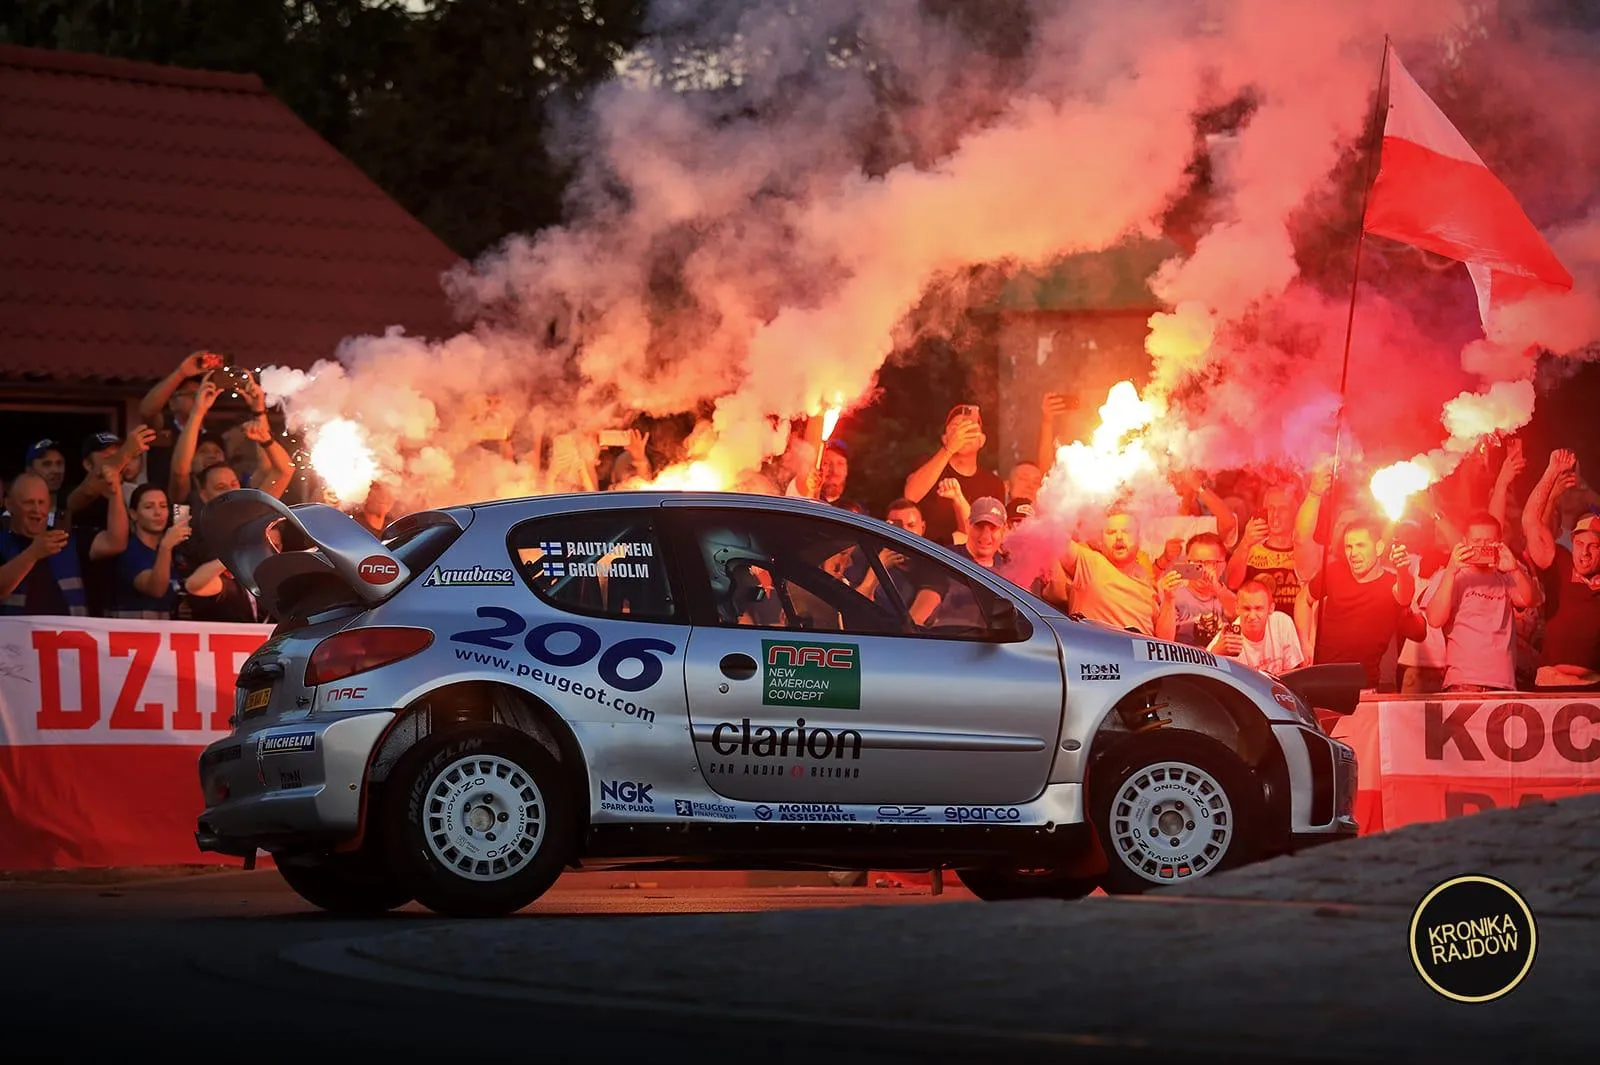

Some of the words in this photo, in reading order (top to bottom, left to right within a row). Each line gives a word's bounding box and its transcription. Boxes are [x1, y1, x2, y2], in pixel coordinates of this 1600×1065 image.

[566, 542, 653, 557] RAUTIAINEN
[361, 563, 397, 575] NAC
[423, 565, 514, 586] Aquabase
[449, 606, 677, 692] 206
[1146, 641, 1218, 667] PETRIHORN
[768, 645, 853, 669] NAC
[769, 668, 796, 678] NEW
[454, 648, 656, 723] www.peugeot.com
[769, 679, 829, 689] AMERICAN
[327, 687, 368, 702] NAC
[768, 690, 824, 701] CONCEPT
[711, 717, 862, 760] clarion
[1424, 702, 1600, 763] KOC
[264, 735, 313, 749] MICHELIN
[710, 763, 734, 774] CAR
[744, 764, 784, 776] AUDIO
[811, 767, 859, 778] BEYOND
[600, 780, 654, 804] NGK
[1153, 784, 1194, 796] RACING
[446, 789, 462, 831] RACING
[601, 802, 626, 811] SPARK
[628, 804, 655, 813] PLUGS
[693, 802, 735, 813] PEUGEOT
[779, 804, 843, 813] MONDIAL
[944, 806, 1019, 823] sparco
[781, 813, 856, 821] ASSISTANCE
[510, 805, 525, 847] RACING
[1147, 851, 1189, 862] RACING
